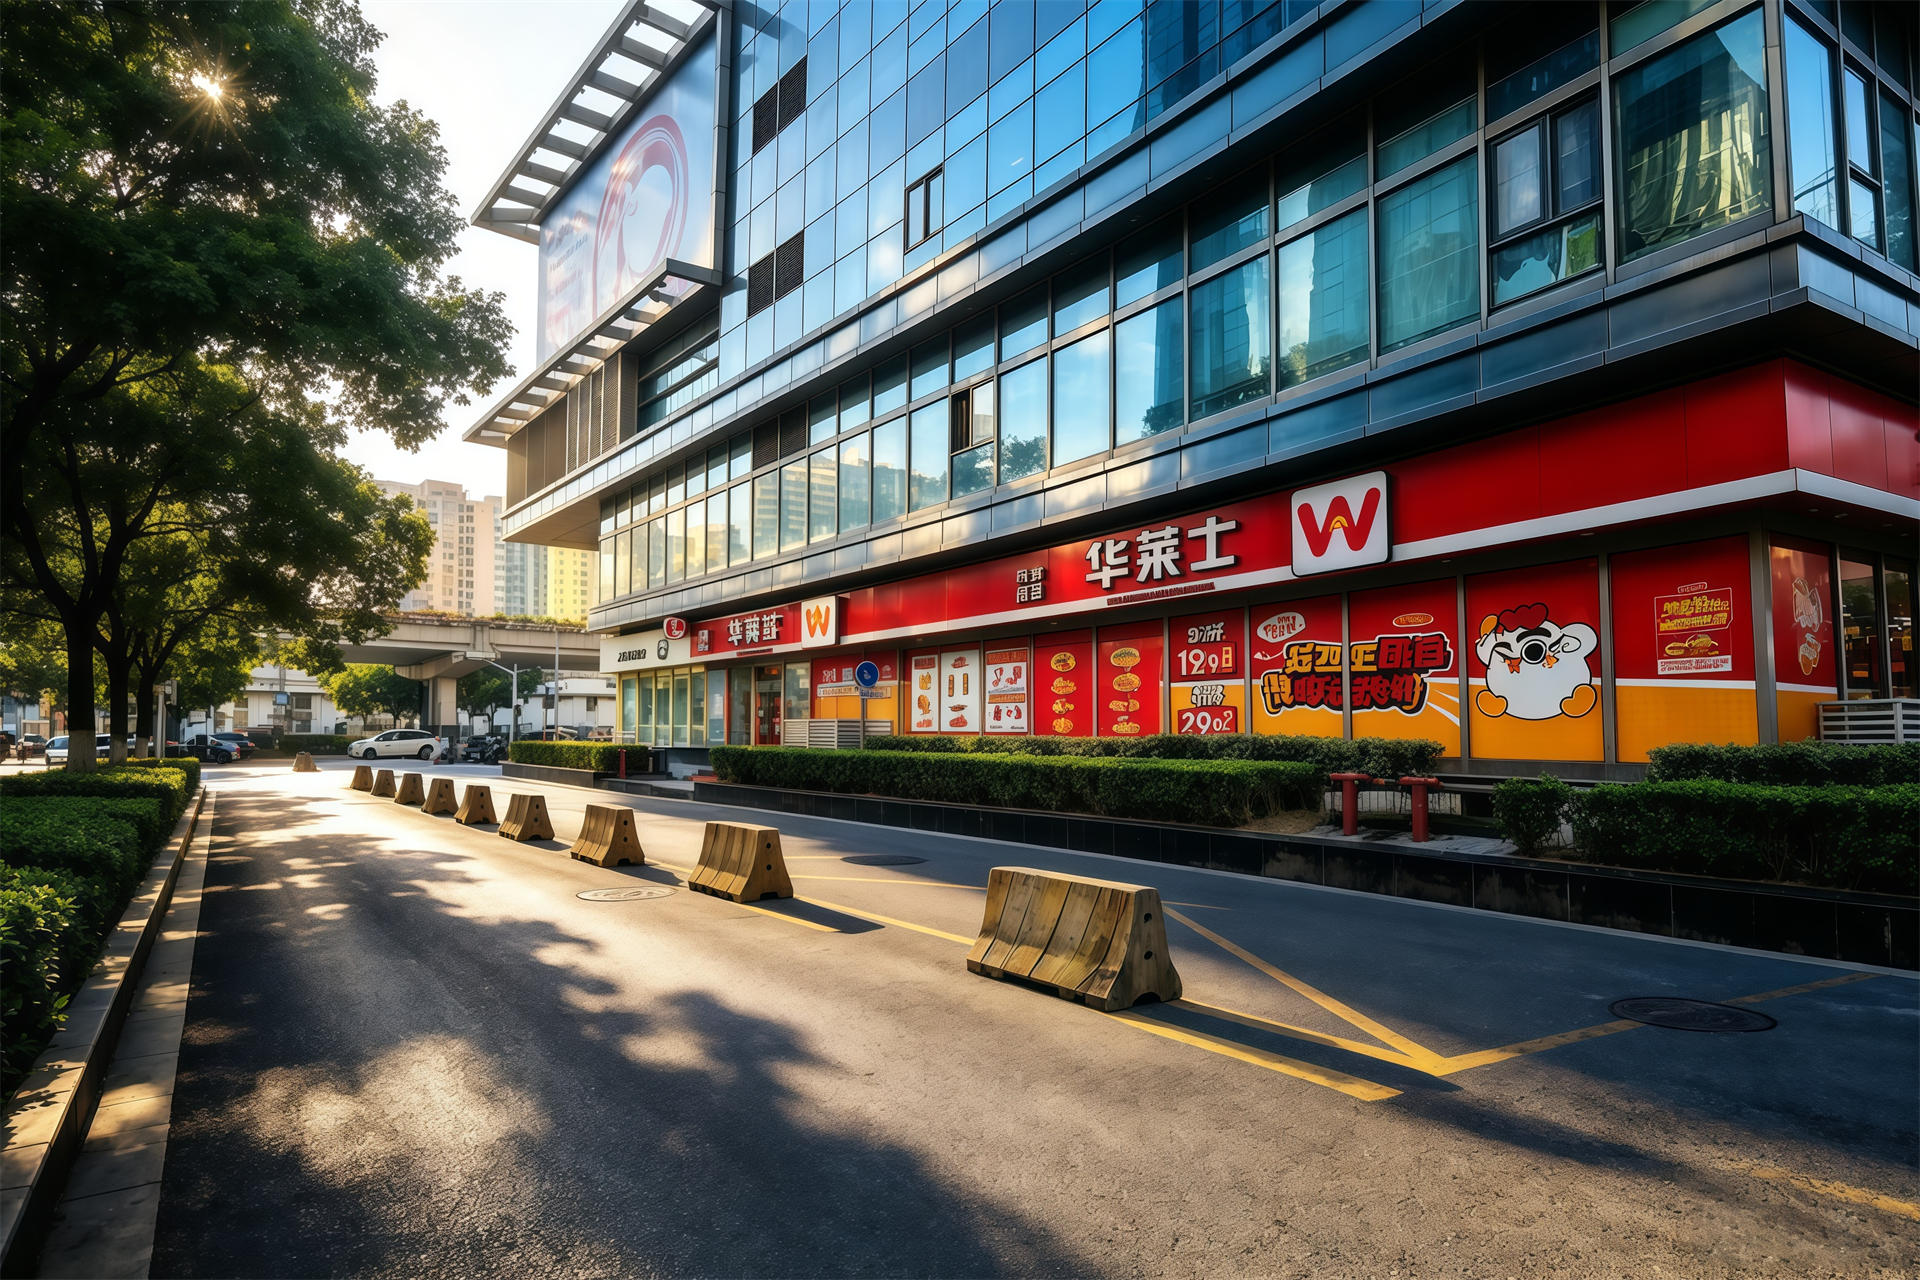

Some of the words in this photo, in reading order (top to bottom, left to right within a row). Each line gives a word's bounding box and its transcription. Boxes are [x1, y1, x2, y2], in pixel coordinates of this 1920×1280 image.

[1085, 516, 1237, 589] 华莱士
[1297, 487, 1381, 557] W
[805, 604, 830, 638] W
